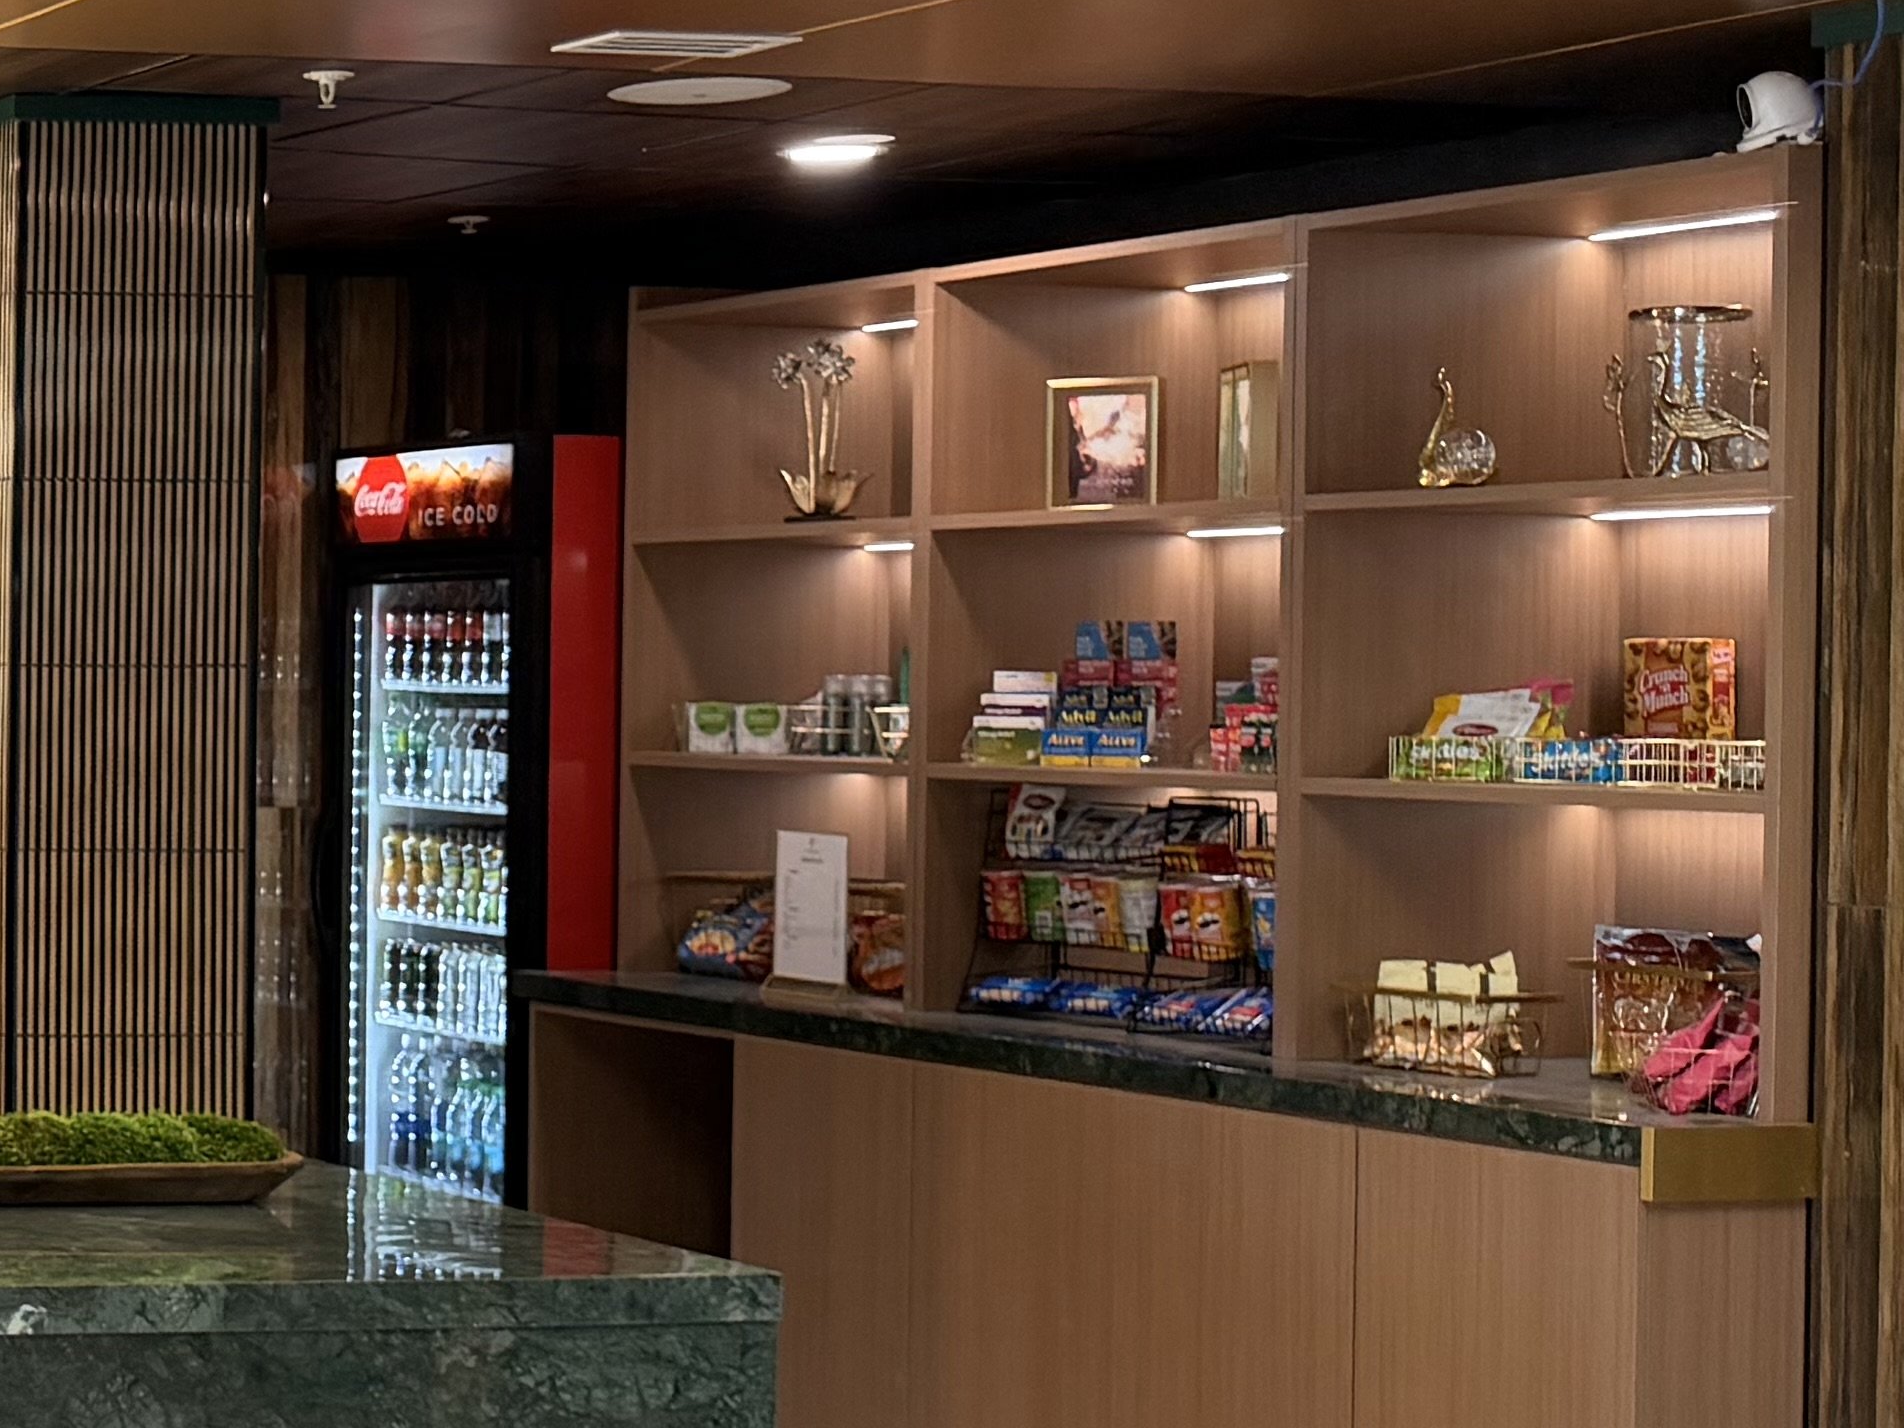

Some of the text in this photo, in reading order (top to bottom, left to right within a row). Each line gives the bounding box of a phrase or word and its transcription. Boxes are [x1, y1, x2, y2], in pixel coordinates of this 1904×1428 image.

[418, 503, 498, 527] ICE COLD
[1639, 664, 1688, 693] Crunch
[1643, 684, 1689, 718] Munch
